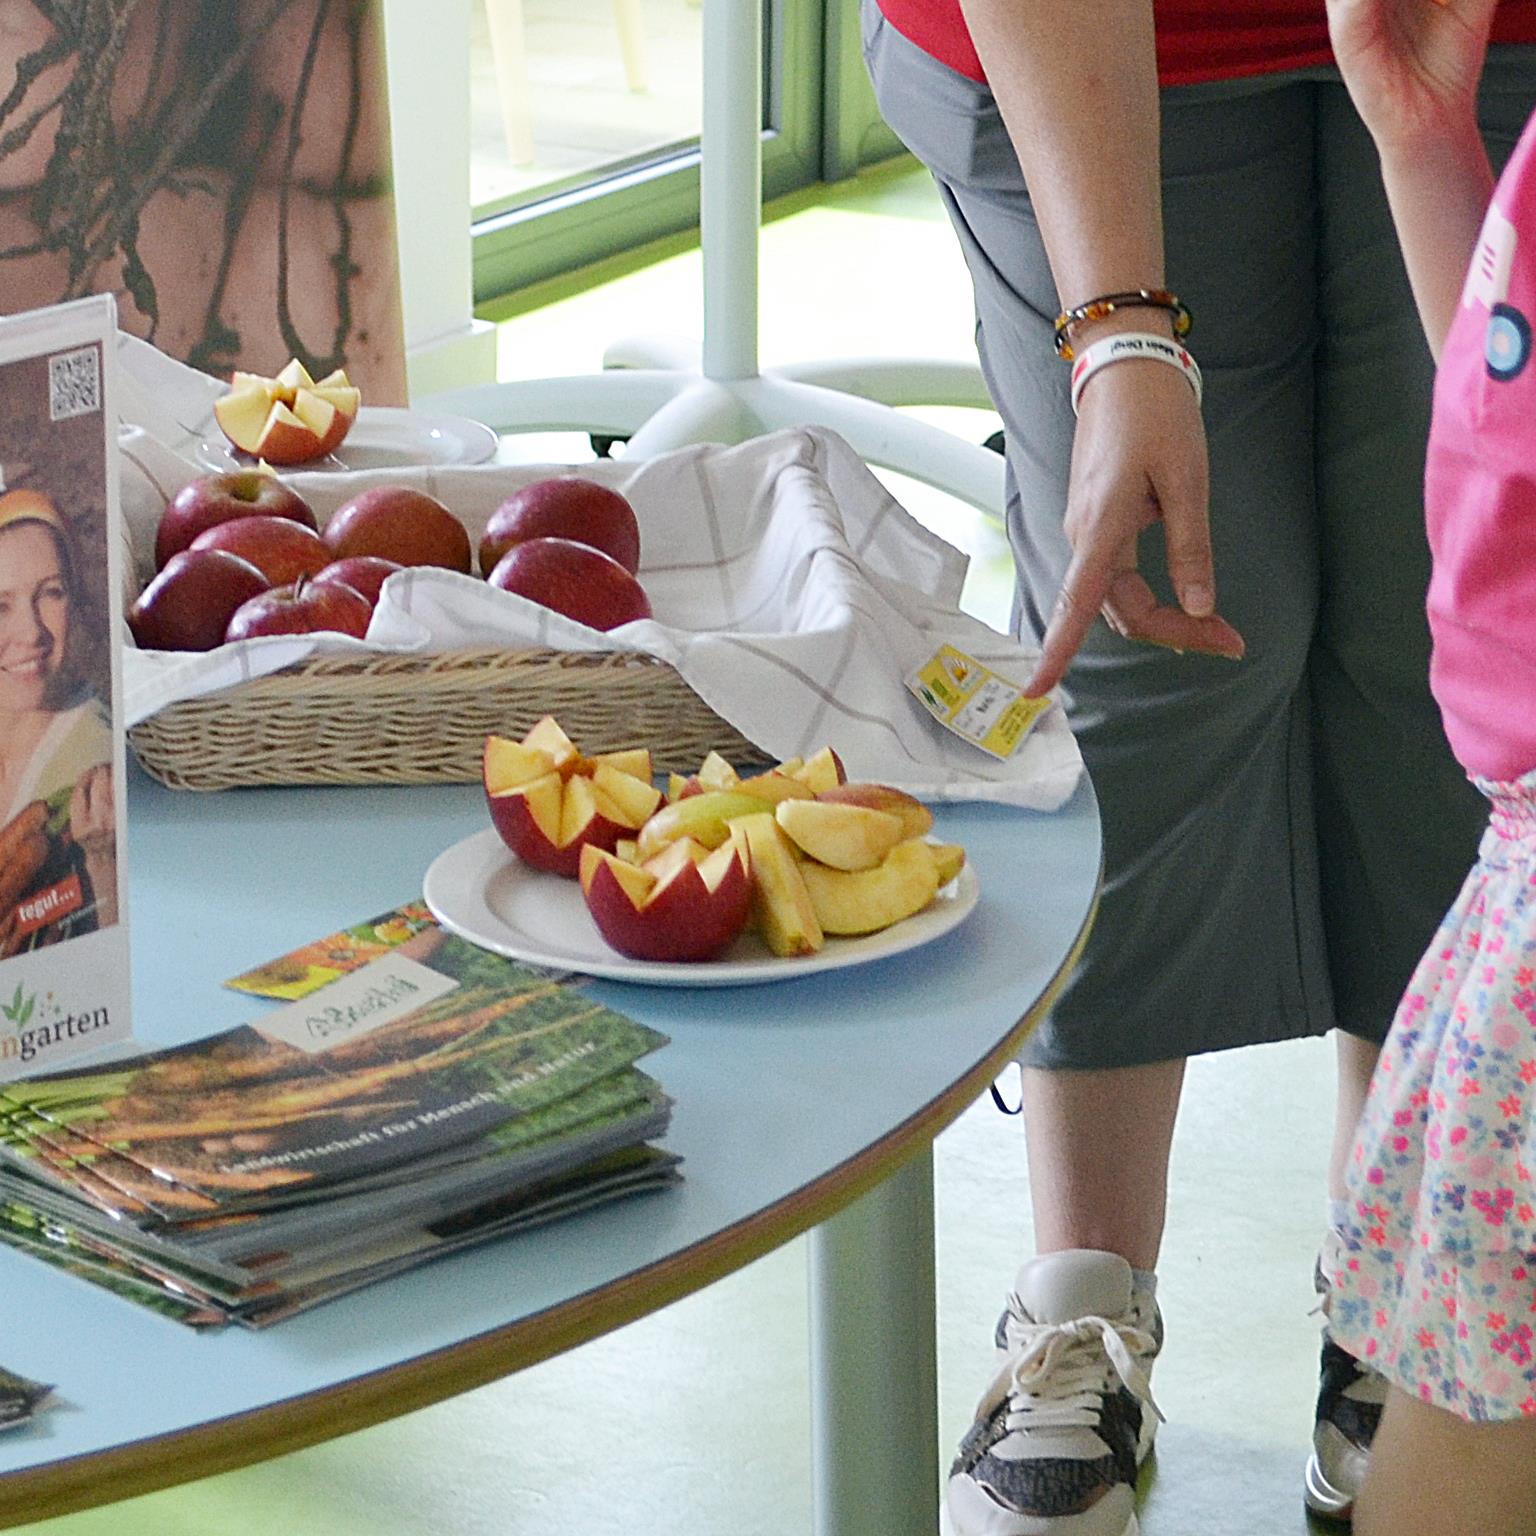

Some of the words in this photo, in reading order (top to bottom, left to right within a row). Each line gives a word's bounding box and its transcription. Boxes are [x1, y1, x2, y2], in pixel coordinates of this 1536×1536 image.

[19, 889, 74, 922] tegut...
[221, 1132, 379, 1175] Landwirtschaft
[381, 1119, 416, 1138] für
[418, 1090, 498, 1126] Mensch
[497, 1071, 536, 1095] und
[538, 1041, 596, 1074] Natur
